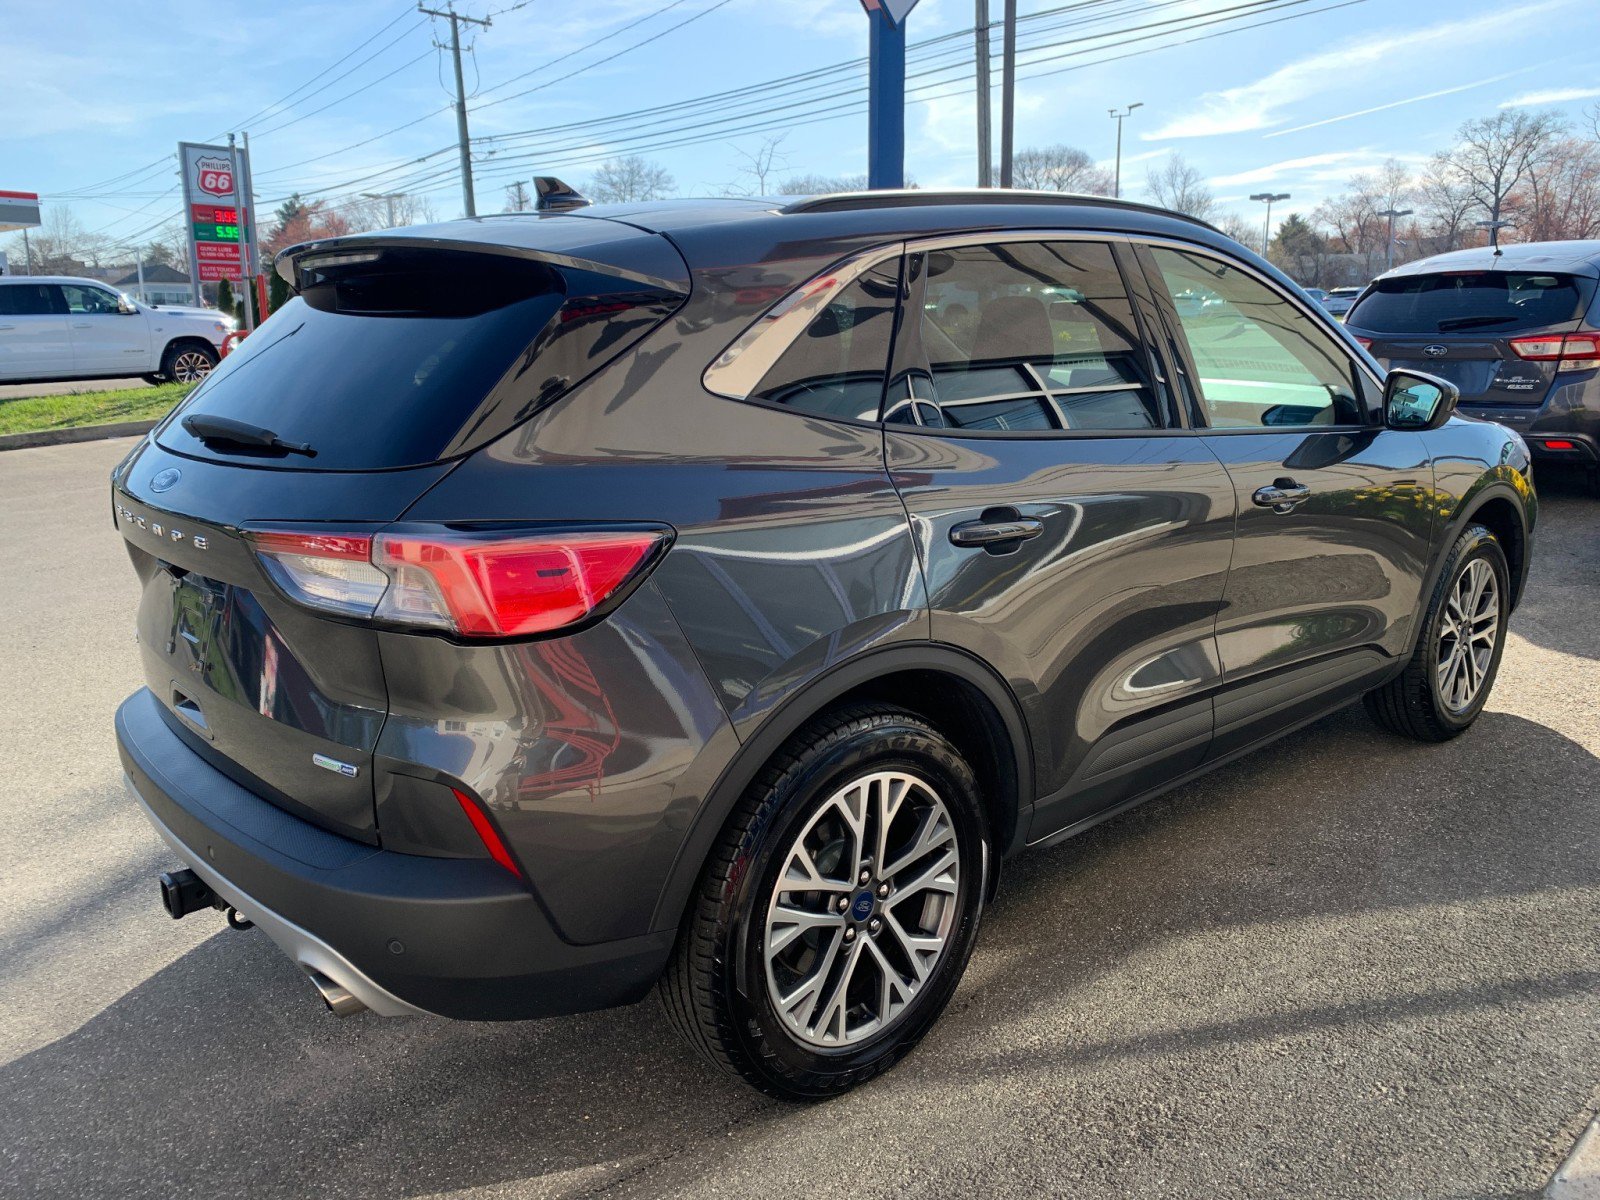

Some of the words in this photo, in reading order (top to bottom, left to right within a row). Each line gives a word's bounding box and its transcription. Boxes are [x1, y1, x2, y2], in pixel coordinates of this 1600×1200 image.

[201, 161, 231, 171] PHILLIPS
[204, 173, 230, 189] 66
[859, 736, 937, 758] EAGLE
